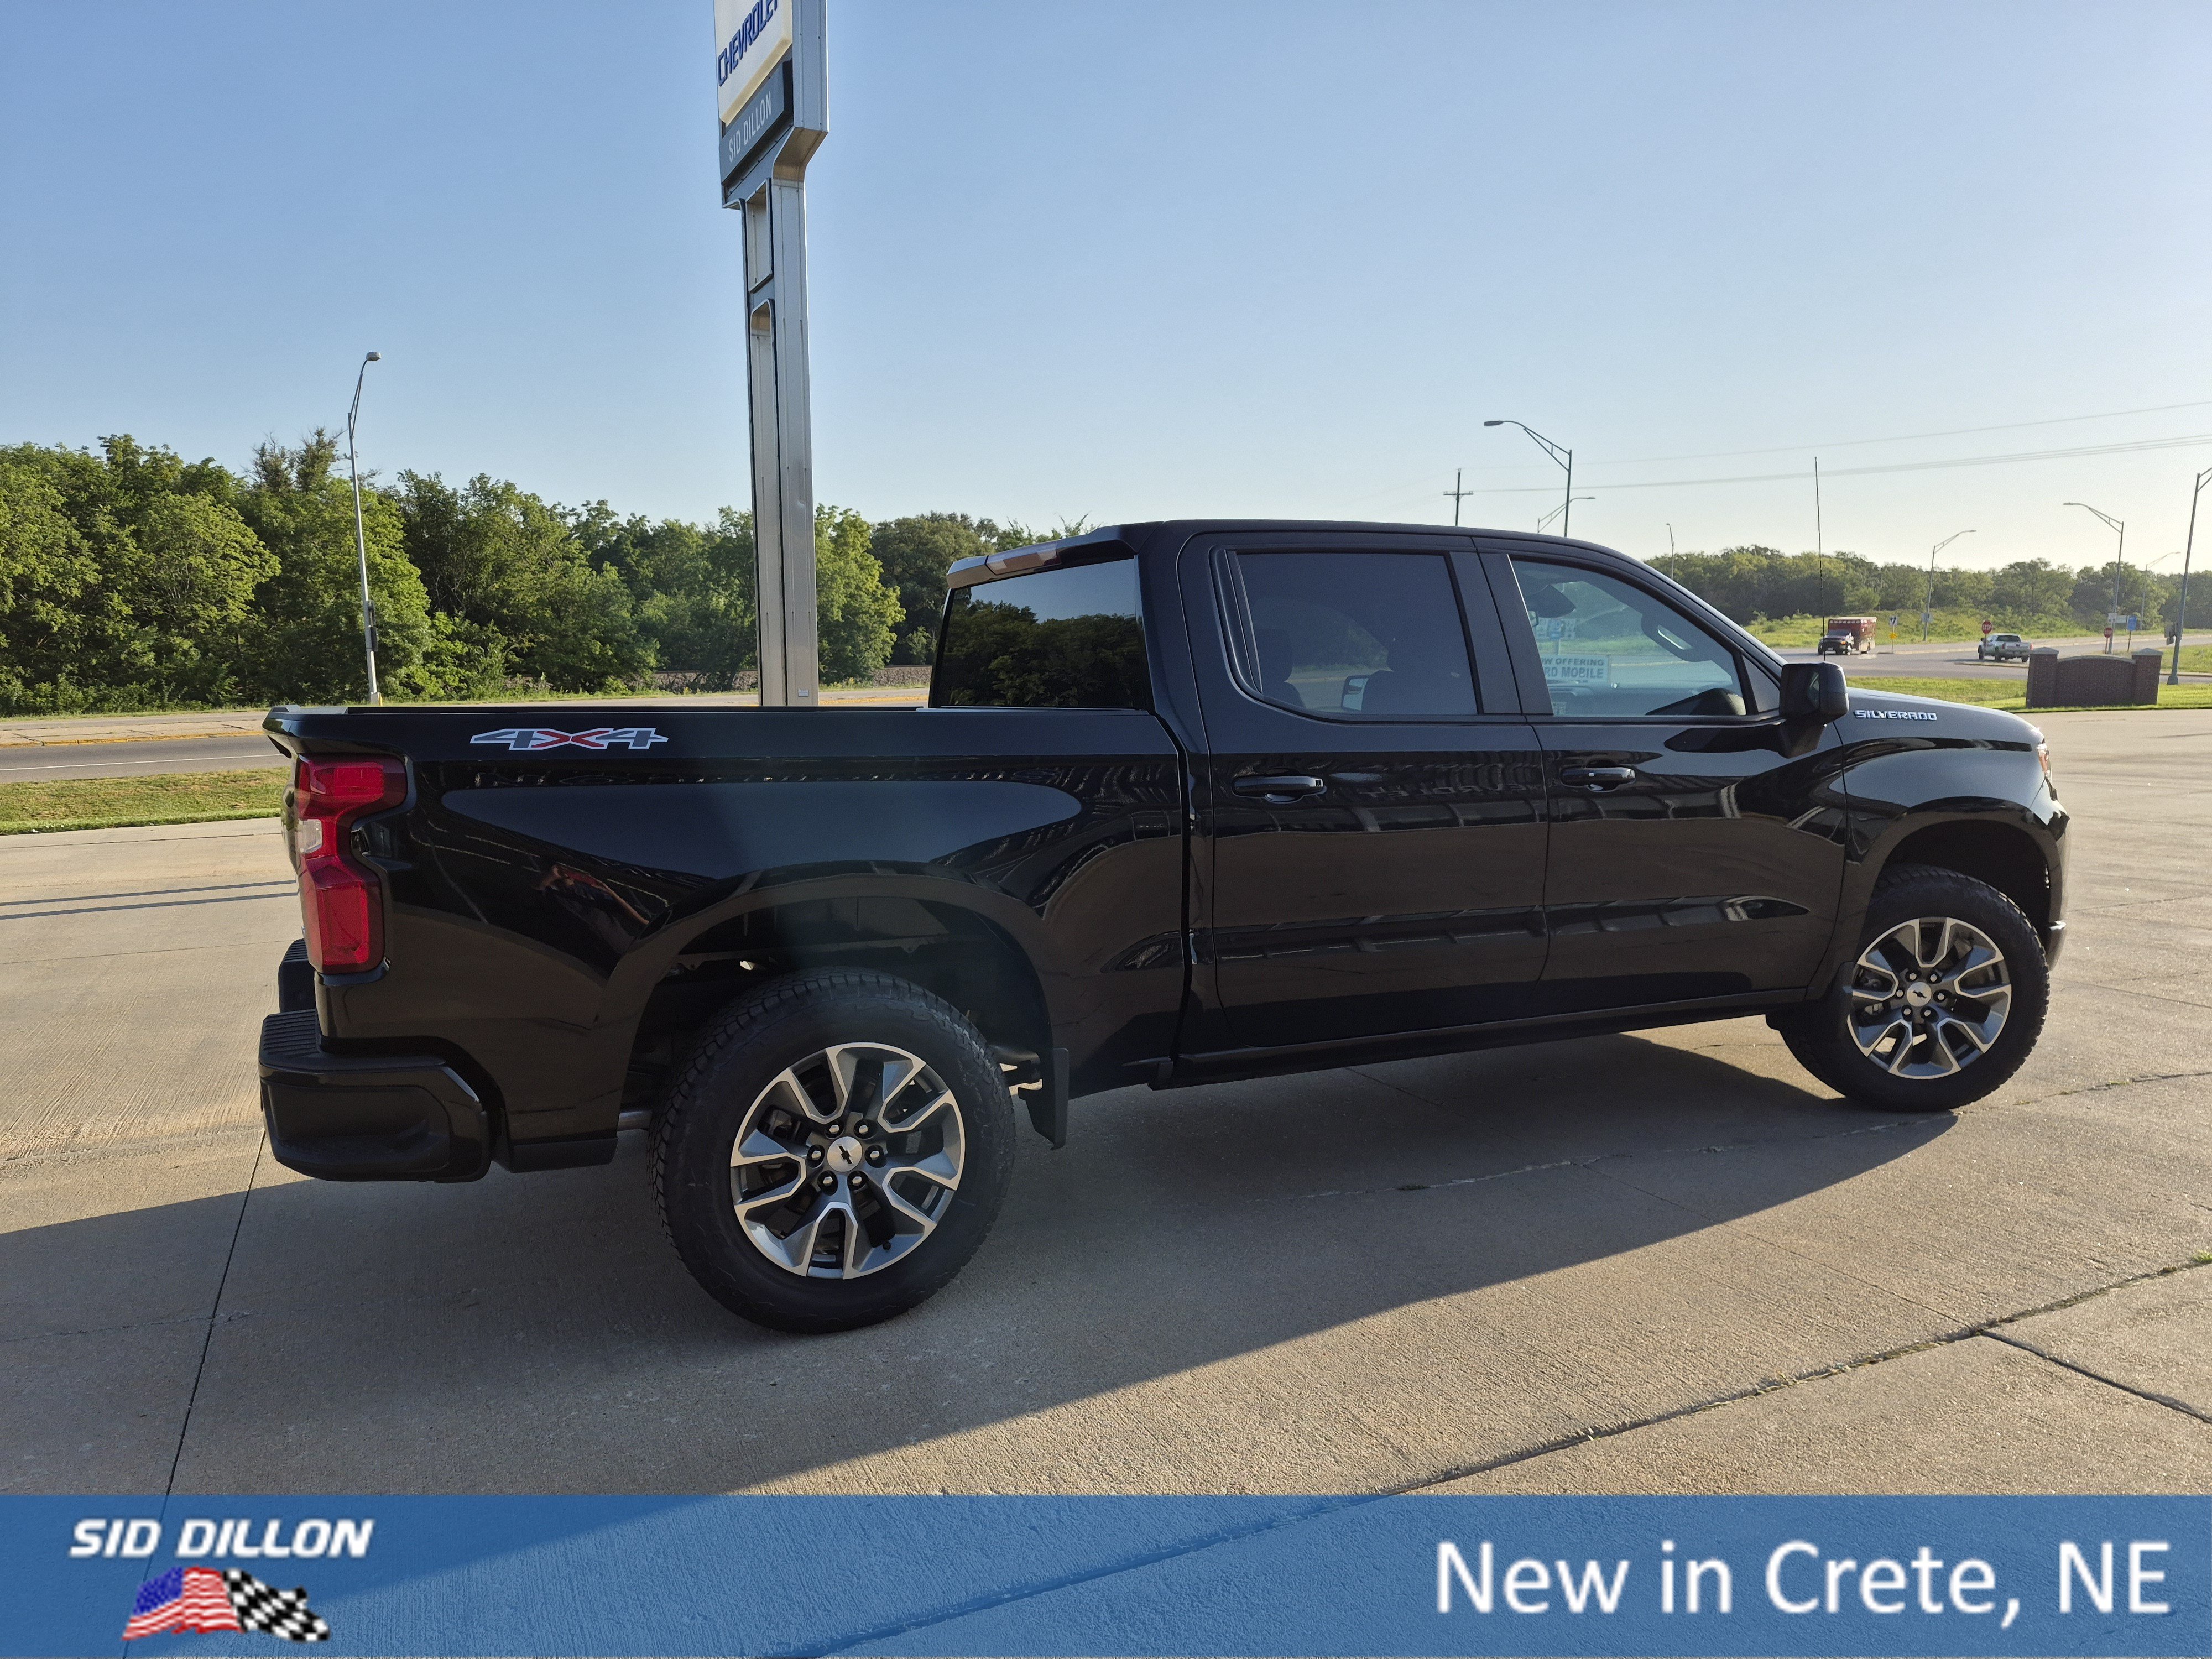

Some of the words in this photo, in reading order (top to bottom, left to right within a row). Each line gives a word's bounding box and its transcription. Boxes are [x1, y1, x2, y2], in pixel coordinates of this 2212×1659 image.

[728, 131, 741, 163] SID
[744, 91, 772, 145] DILLON
[1555, 658, 1604, 666] OFFERING
[1561, 666, 1604, 679] MOBILE
[1853, 709, 1938, 721] SILVERADO
[469, 728, 669, 751] 4X4
